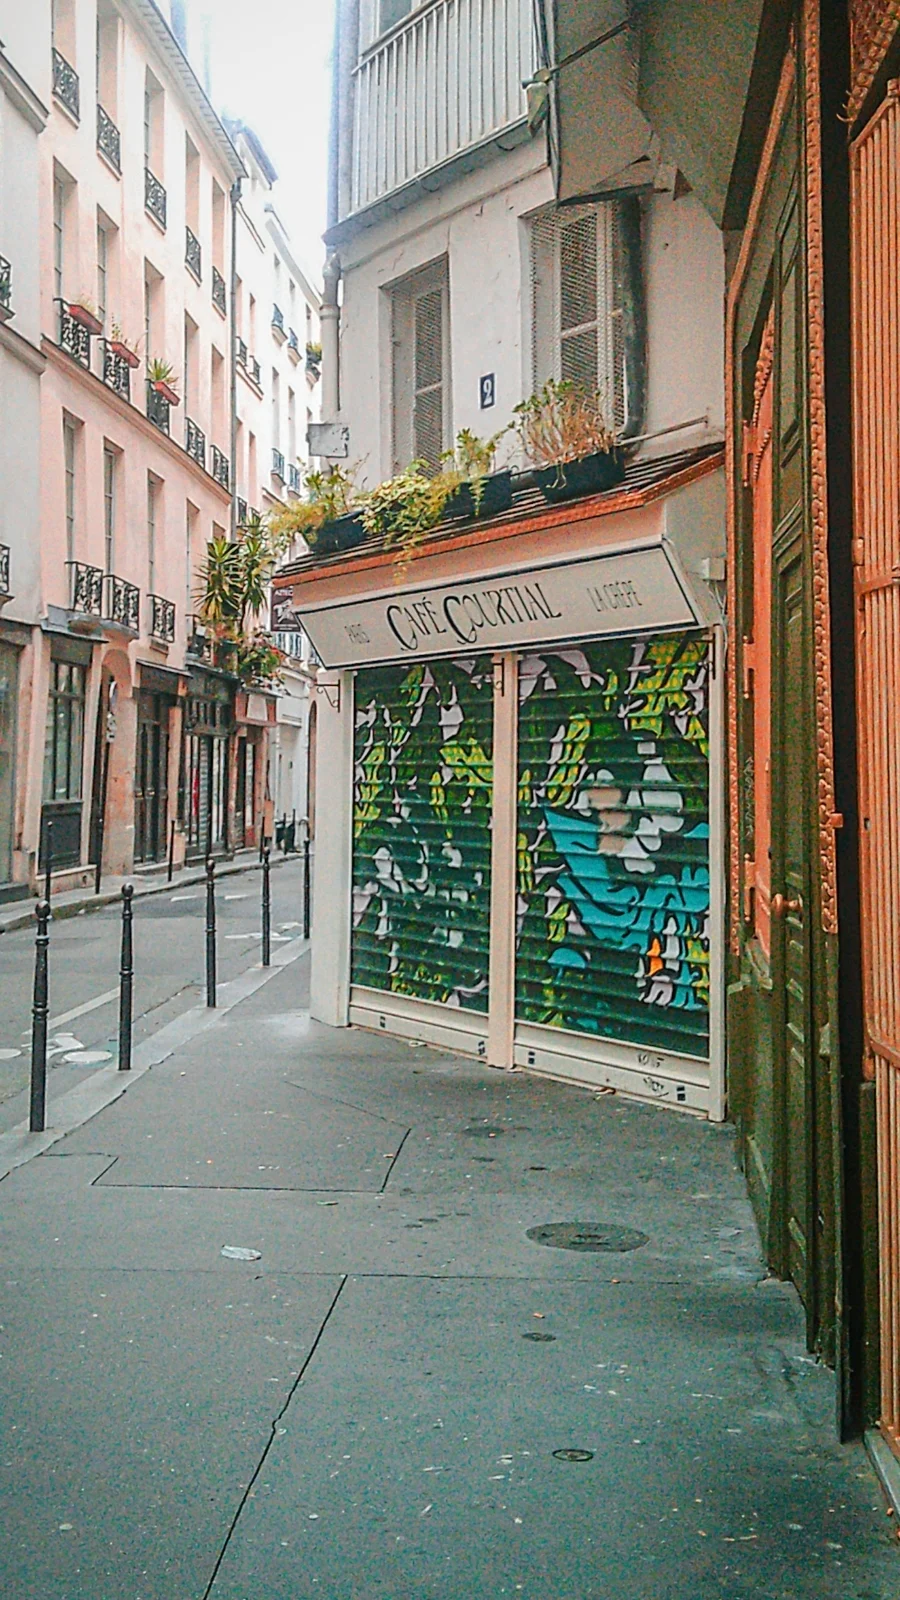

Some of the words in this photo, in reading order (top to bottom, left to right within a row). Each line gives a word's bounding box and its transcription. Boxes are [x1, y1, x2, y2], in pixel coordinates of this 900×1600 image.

[482, 378, 493, 406] 2
[586, 587, 609, 612] LA
[386, 596, 447, 651] CAFÉ
[443, 582, 562, 644] COURTIAL
